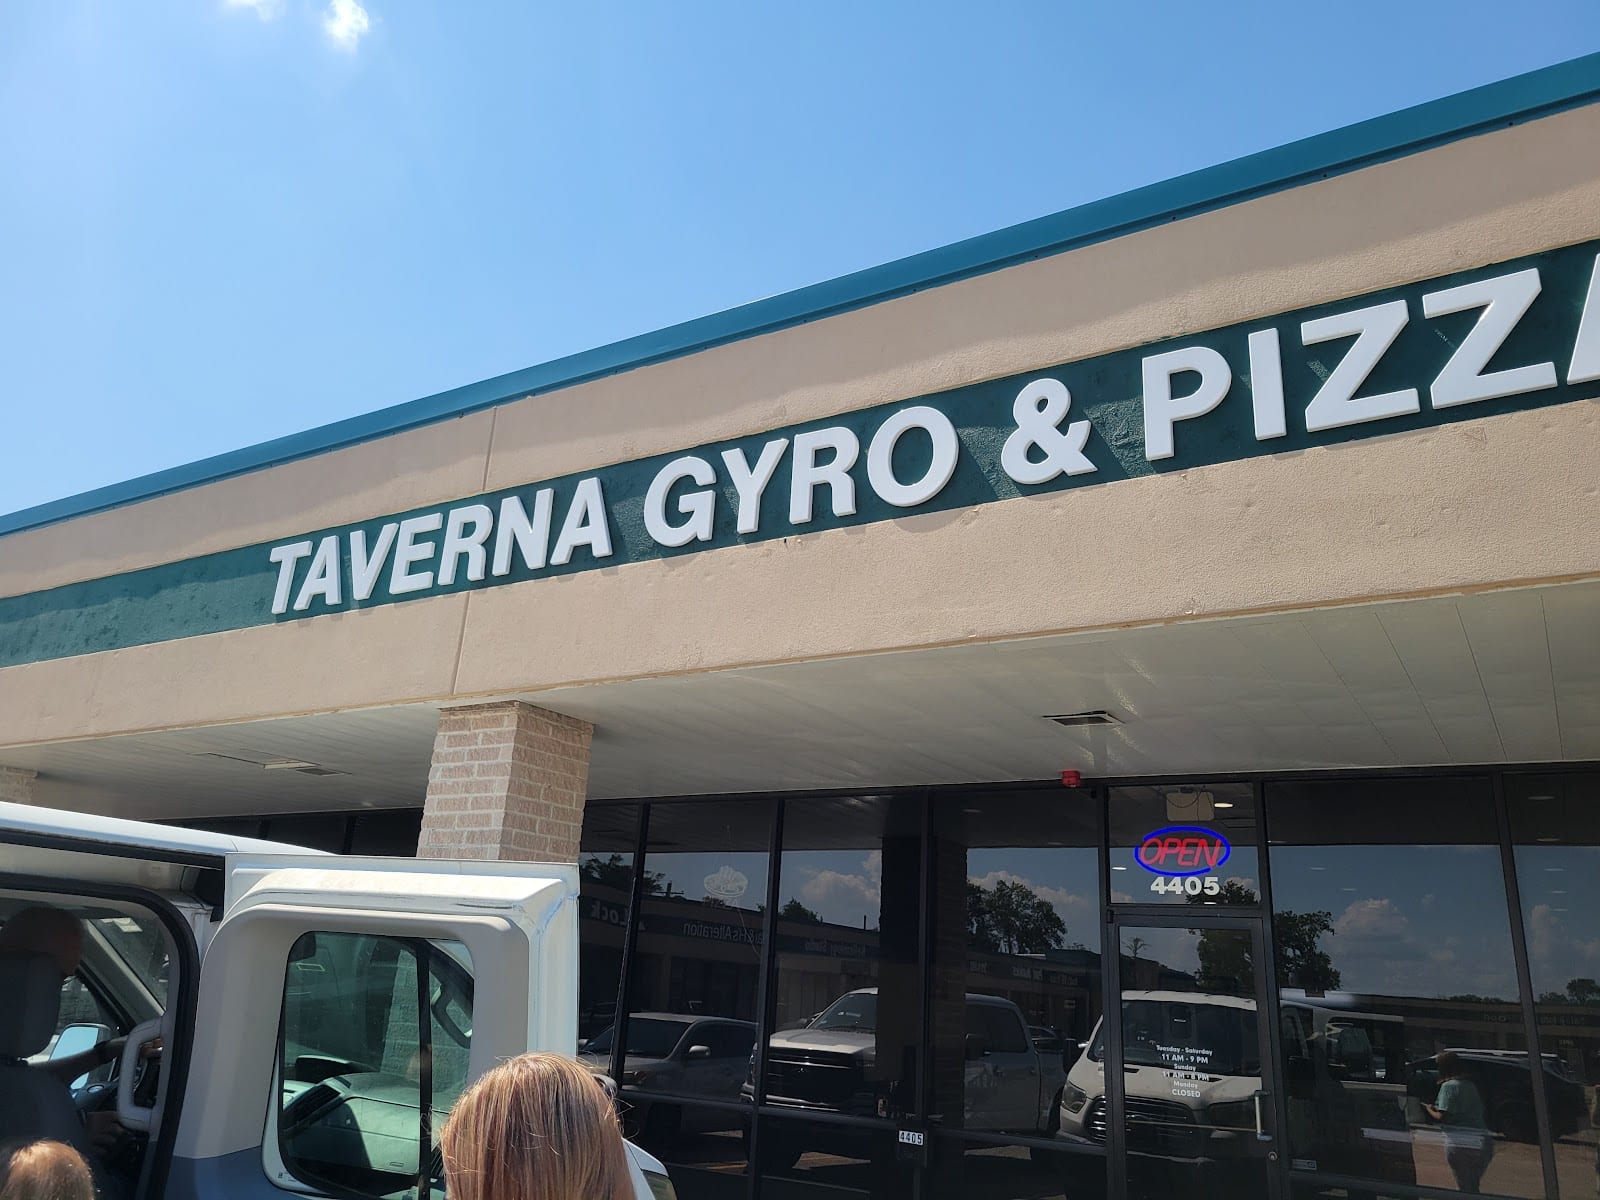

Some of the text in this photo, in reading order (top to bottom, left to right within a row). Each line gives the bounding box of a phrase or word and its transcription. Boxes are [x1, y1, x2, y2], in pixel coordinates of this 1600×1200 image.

[269, 476, 613, 615] TAVERNA
[643, 405, 959, 548] GYRO
[1001, 377, 1097, 485] &
[1140, 838, 1222, 867] OPEN
[1150, 876, 1220, 896] 4405
[1156, 1045, 1180, 1053] Tuesday
[1185, 1047, 1212, 1056] Saturday
[1171, 1054, 1184, 1062] AM
[1190, 1055, 1195, 1063] 9
[1196, 1056, 1209, 1064] PM
[1174, 1063, 1196, 1071] Sunday
[1173, 1081, 1197, 1089] Monday
[1172, 1089, 1200, 1097] CLOSED
[900, 1132, 922, 1144] 4405
